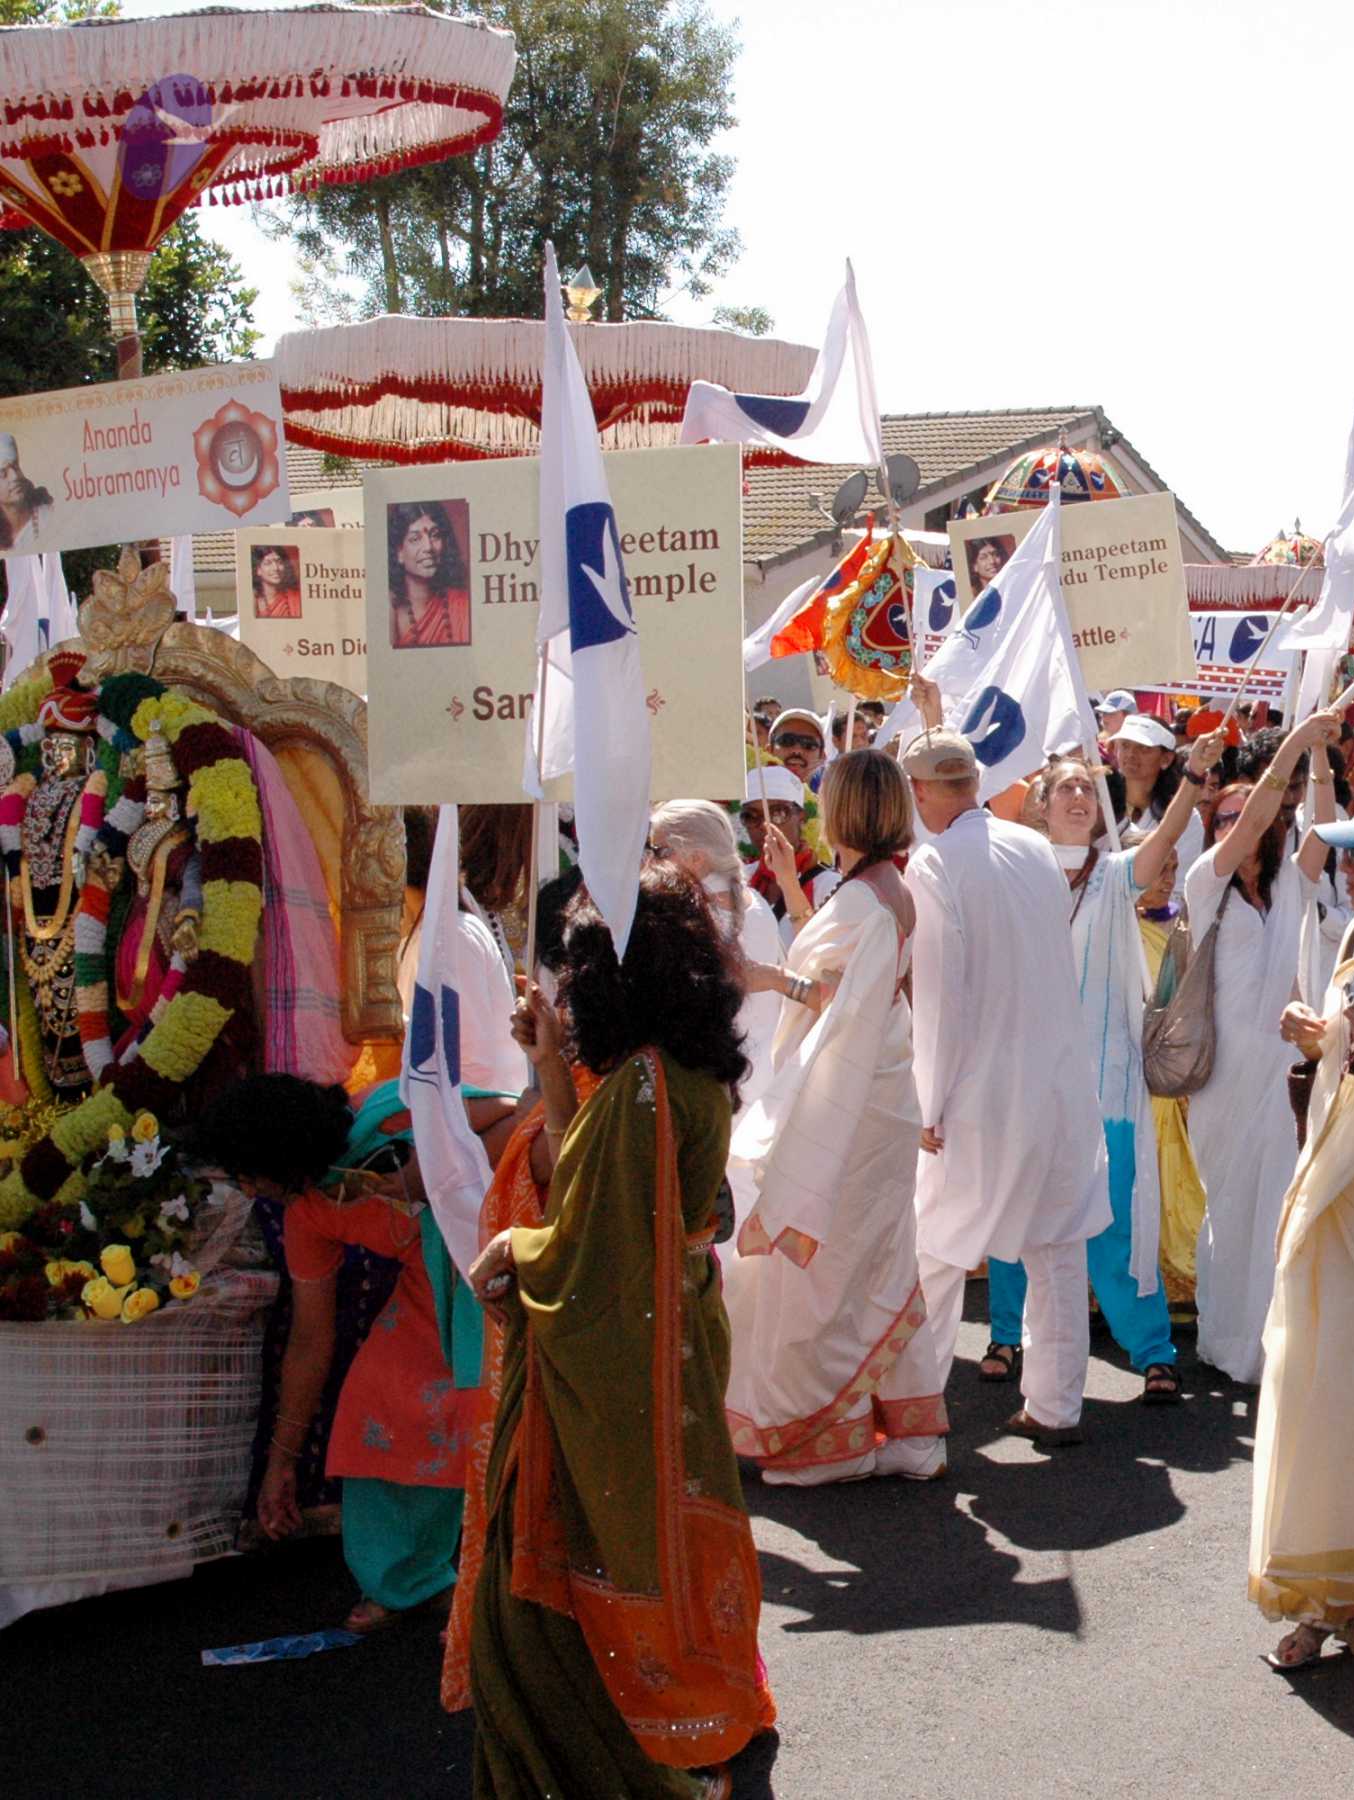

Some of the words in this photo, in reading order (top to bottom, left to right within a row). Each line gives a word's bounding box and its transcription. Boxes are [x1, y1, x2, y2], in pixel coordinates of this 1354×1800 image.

[83, 409, 151, 453] Ananda
[63, 463, 180, 501] Subramanya
[1094, 558, 1169, 582] Temple
[308, 584, 362, 600] Hindu
[297, 639, 334, 656] San
[1072, 626, 1117, 649] attle
